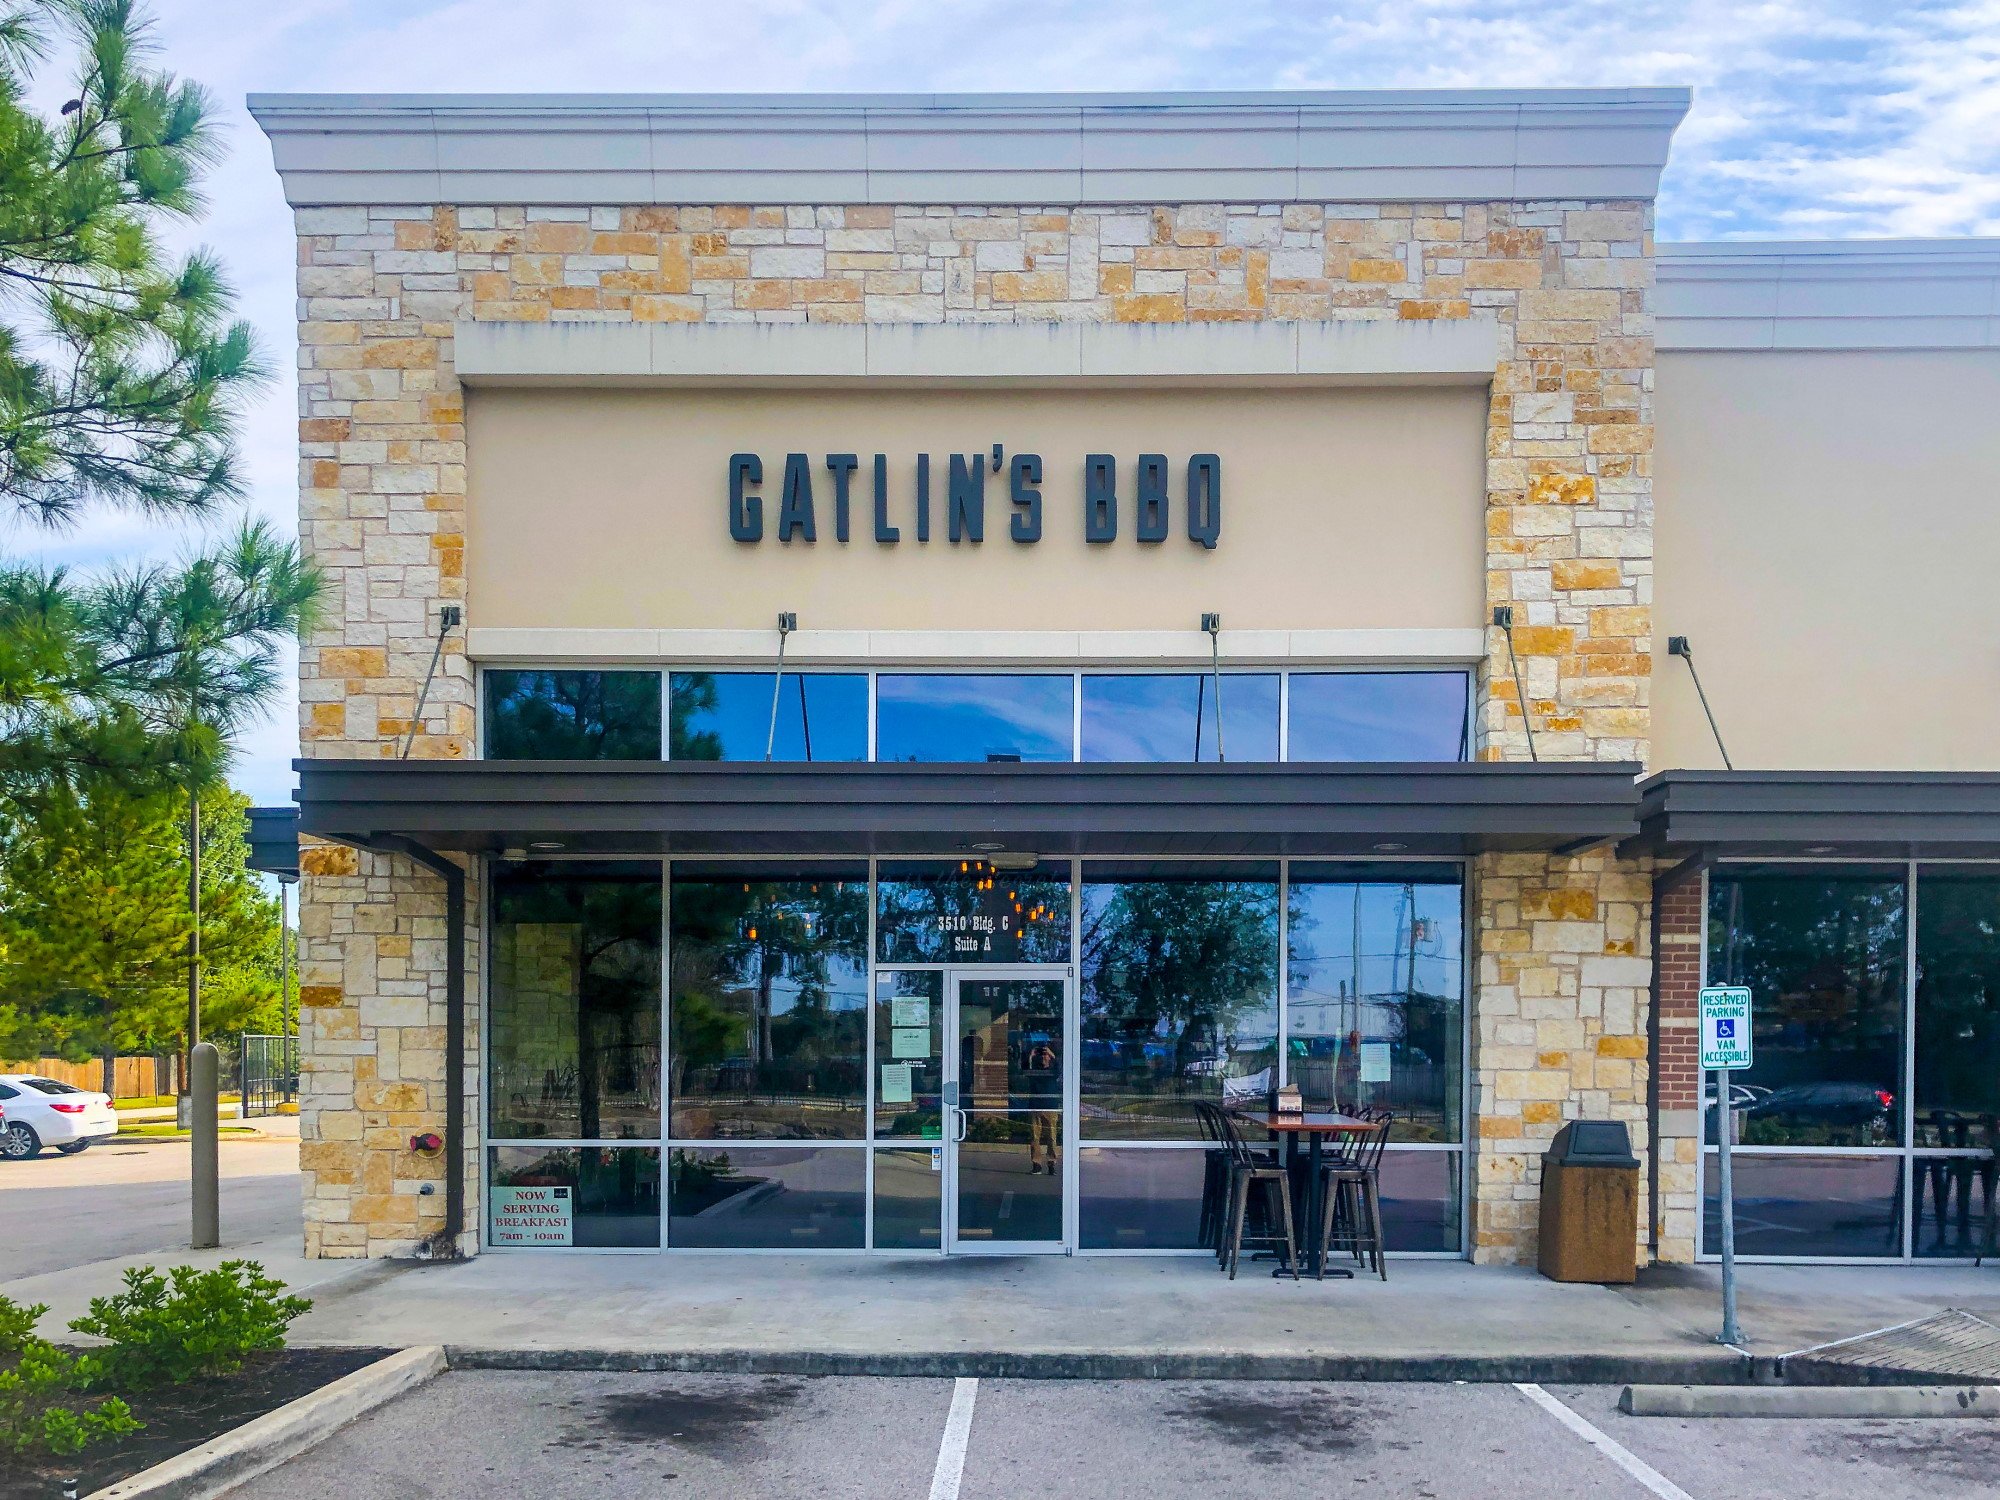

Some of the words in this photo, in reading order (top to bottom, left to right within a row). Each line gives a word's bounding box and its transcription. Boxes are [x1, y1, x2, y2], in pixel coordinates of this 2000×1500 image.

[730, 443, 1043, 543] GATLIN'S
[1085, 453, 1220, 549] BBQ
[938, 915, 967, 931] 3510
[972, 915, 996, 934] Bldg.
[1002, 915, 1009, 931] C
[954, 936, 979, 952] Suite
[983, 936, 992, 951] A
[1704, 995, 1747, 1005] RESERVED
[1706, 1007, 1745, 1017] PARKING
[1717, 1040, 1736, 1049] VAN
[1705, 1051, 1748, 1062] ACCESSIBLE
[515, 1191, 547, 1200] NOW
[503, 1204, 560, 1214] SERVING
[495, 1217, 569, 1227] BREAKFAST
[499, 1232, 523, 1241] 7am
